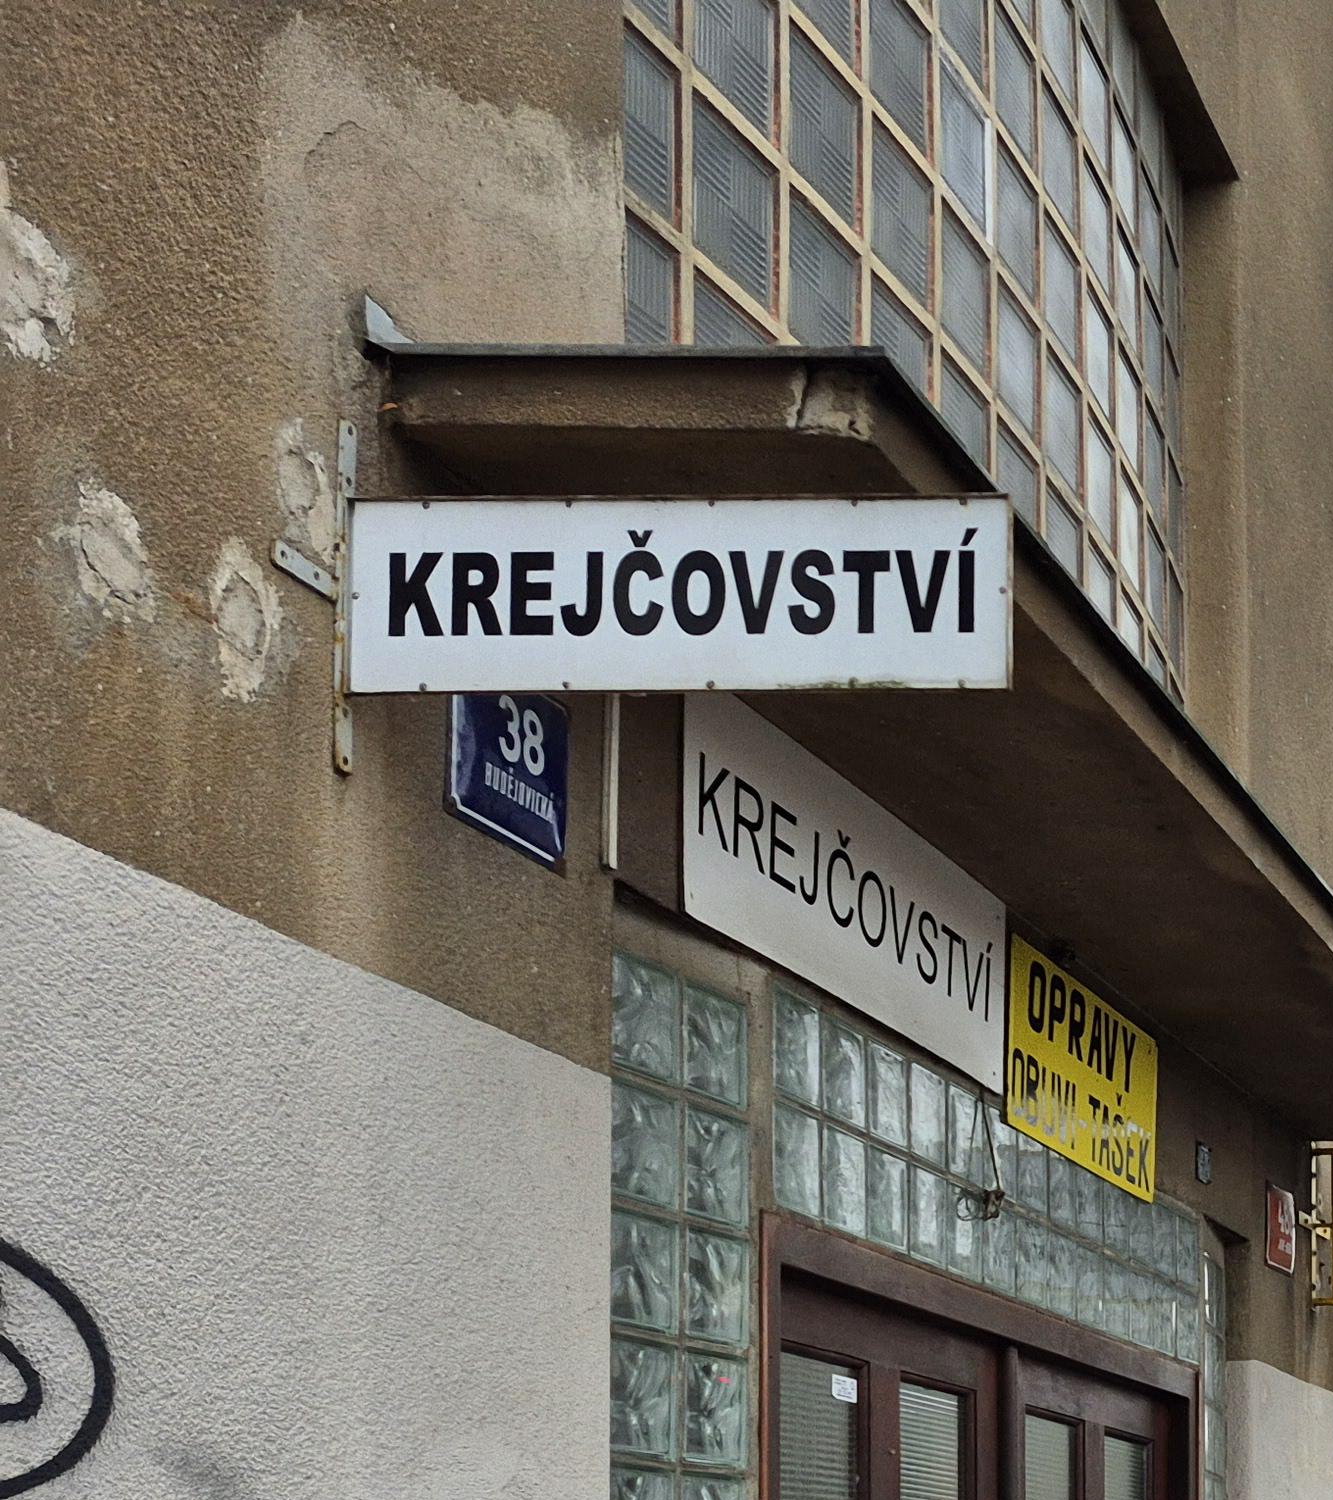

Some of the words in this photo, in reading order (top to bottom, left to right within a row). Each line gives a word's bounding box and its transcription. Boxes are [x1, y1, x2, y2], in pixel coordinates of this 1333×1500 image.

[387, 528, 979, 637] KREJČOVSTVÍ
[498, 694, 545, 776] 38
[484, 761, 557, 824] BUDĚJOVICKÁ
[698, 751, 993, 1022] KREJČOVSTVÍ
[1027, 960, 1137, 1093] OPRAVY
